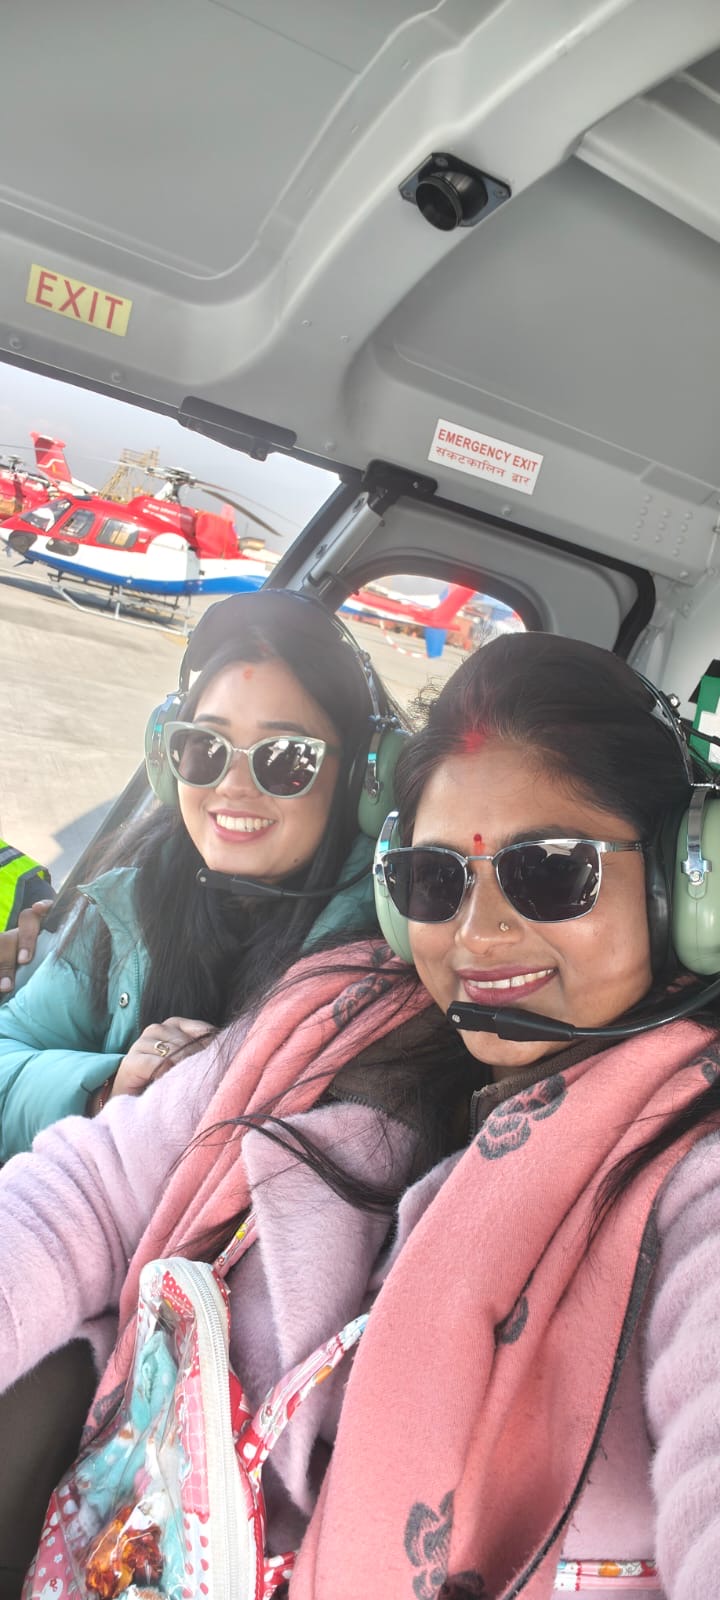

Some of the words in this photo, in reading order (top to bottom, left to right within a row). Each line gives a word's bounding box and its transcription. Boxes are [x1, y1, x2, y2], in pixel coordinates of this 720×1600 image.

[35, 271, 124, 329] EXIT
[437, 428, 512, 464] EMERGENCY
[512, 455, 539, 473] EXIT
